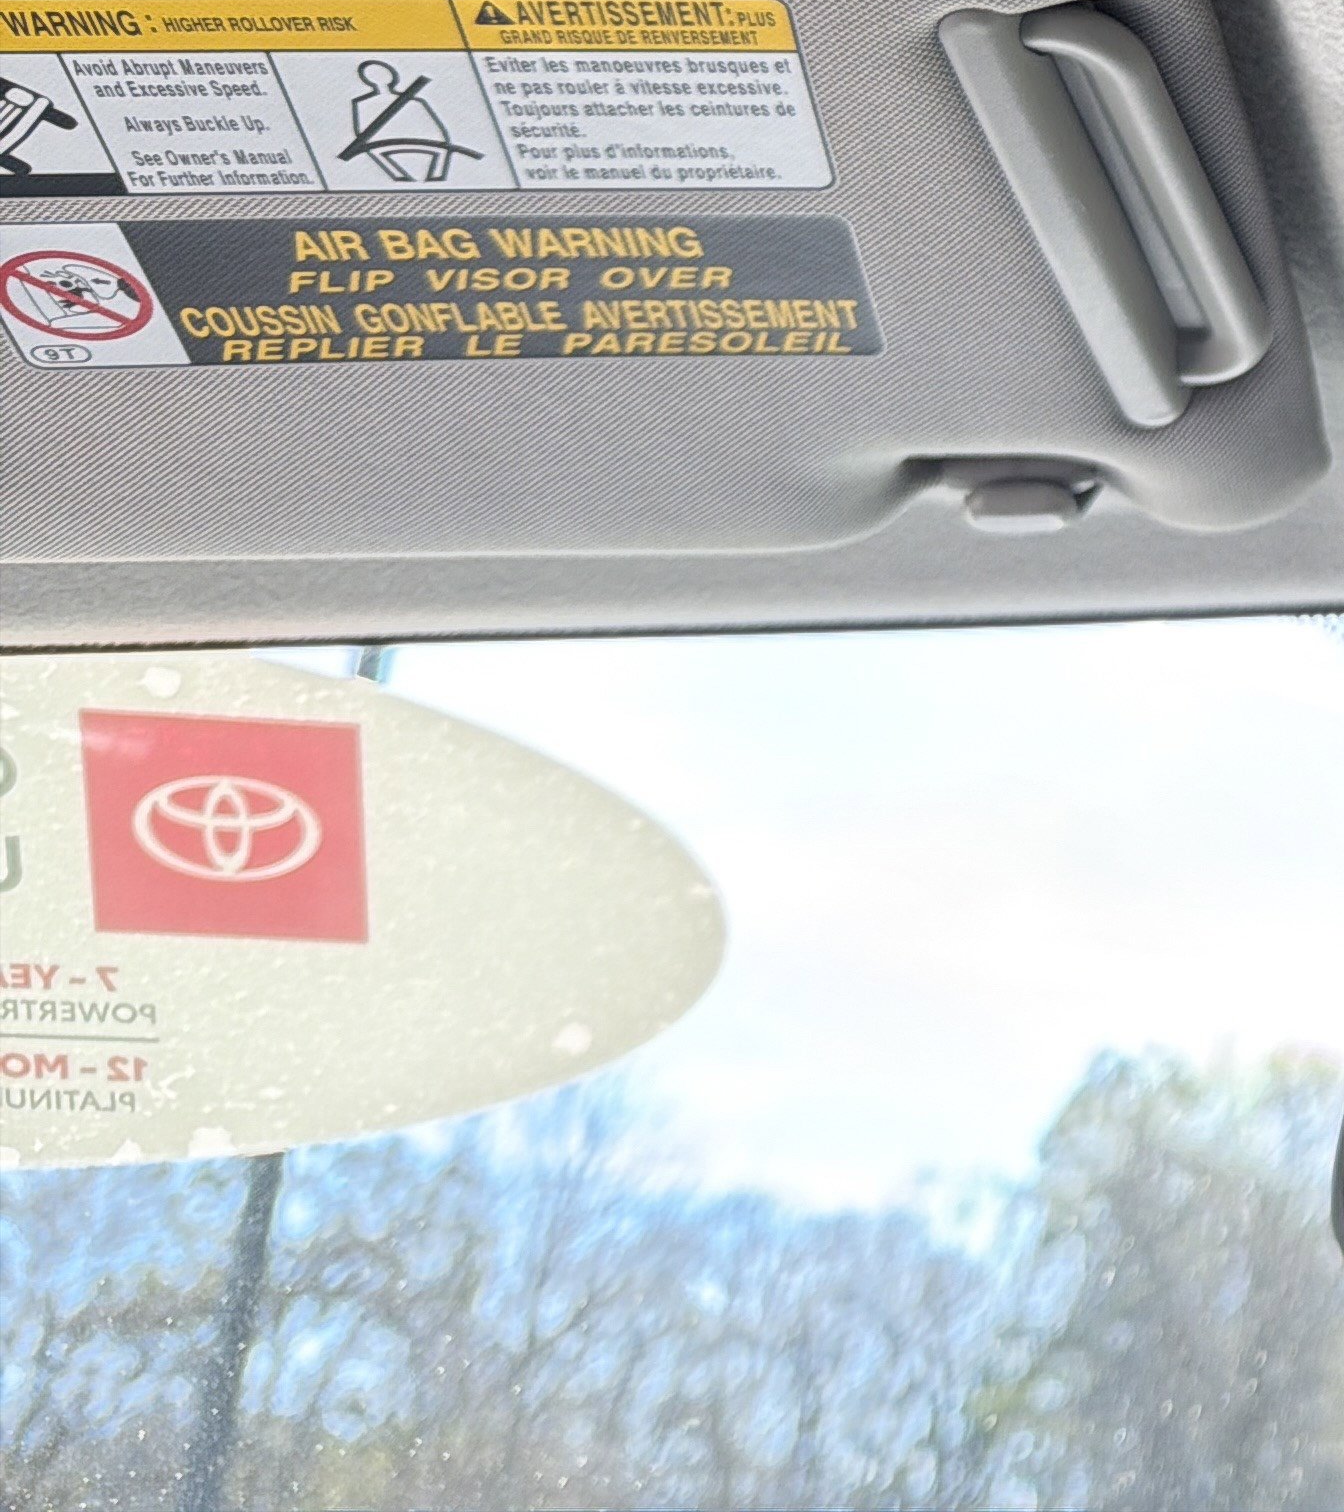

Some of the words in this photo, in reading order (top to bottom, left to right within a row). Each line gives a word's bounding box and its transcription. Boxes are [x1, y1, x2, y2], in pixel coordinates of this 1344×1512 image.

[162, 16, 227, 32] HIGHER
[230, 16, 314, 32] ROLLOVER
[317, 16, 357, 32] RISK
[515, 1, 733, 27] AVERTISSEMENT:
[738, 12, 776, 27] PLUS
[500, 30, 553, 45] GRAND
[556, 30, 613, 46] RISQUE
[617, 30, 637, 45] DE
[640, 30, 759, 45] RENVERSEMENT
[73, 59, 118, 77] Avoid
[123, 59, 175, 80] Abrupt
[181, 59, 269, 75] Maneuvers
[543, 56, 568, 73] les
[575, 59, 681, 73] manoeuvres
[687, 56, 769, 77] brusques
[775, 57, 791, 73] et
[94, 82, 126, 98] and
[129, 82, 205, 98] Excessive
[210, 82, 268, 100] Speed.
[494, 82, 516, 95] ne
[522, 82, 553, 99] pas
[558, 79, 609, 95] rouler
[631, 79, 691, 95] vitesse
[697, 79, 789, 95] excessive.
[500, 100, 579, 120] Toujours
[584, 101, 654, 117] attacher
[658, 101, 685, 117] les
[690, 102, 771, 117] ceintures
[776, 101, 796, 117] de
[125, 116, 181, 136] Always
[185, 115, 239, 132] Buckle
[243, 116, 269, 135] Up.
[511, 122, 587, 138] sécurité.
[131, 150, 161, 167] See
[165, 150, 230, 167] Owner's
[233, 149, 292, 165] Manual
[517, 144, 560, 159] Pour
[565, 144, 600, 162] plus
[127, 171, 153, 187] For
[157, 171, 216, 187] Further
[219, 170, 314, 186] Information.
[526, 165, 558, 180] voir
[562, 165, 580, 180] le
[584, 165, 647, 180] manuel
[652, 165, 672, 180] du
[294, 230, 370, 261] AIR
[378, 228, 481, 260] BAG
[488, 226, 705, 259] WARNING
[289, 270, 395, 293] FLIP
[426, 267, 570, 291] VISOR
[601, 266, 733, 289] OVER
[180, 305, 343, 338] COUSSIN
[354, 300, 567, 335] GONFLABLE
[584, 299, 857, 331] AVERTISSEMENT
[44, 348, 77, 361] 9T
[223, 337, 425, 362] REPLIER
[465, 334, 522, 357] LE
[562, 331, 853, 355] PARESOLEIL
